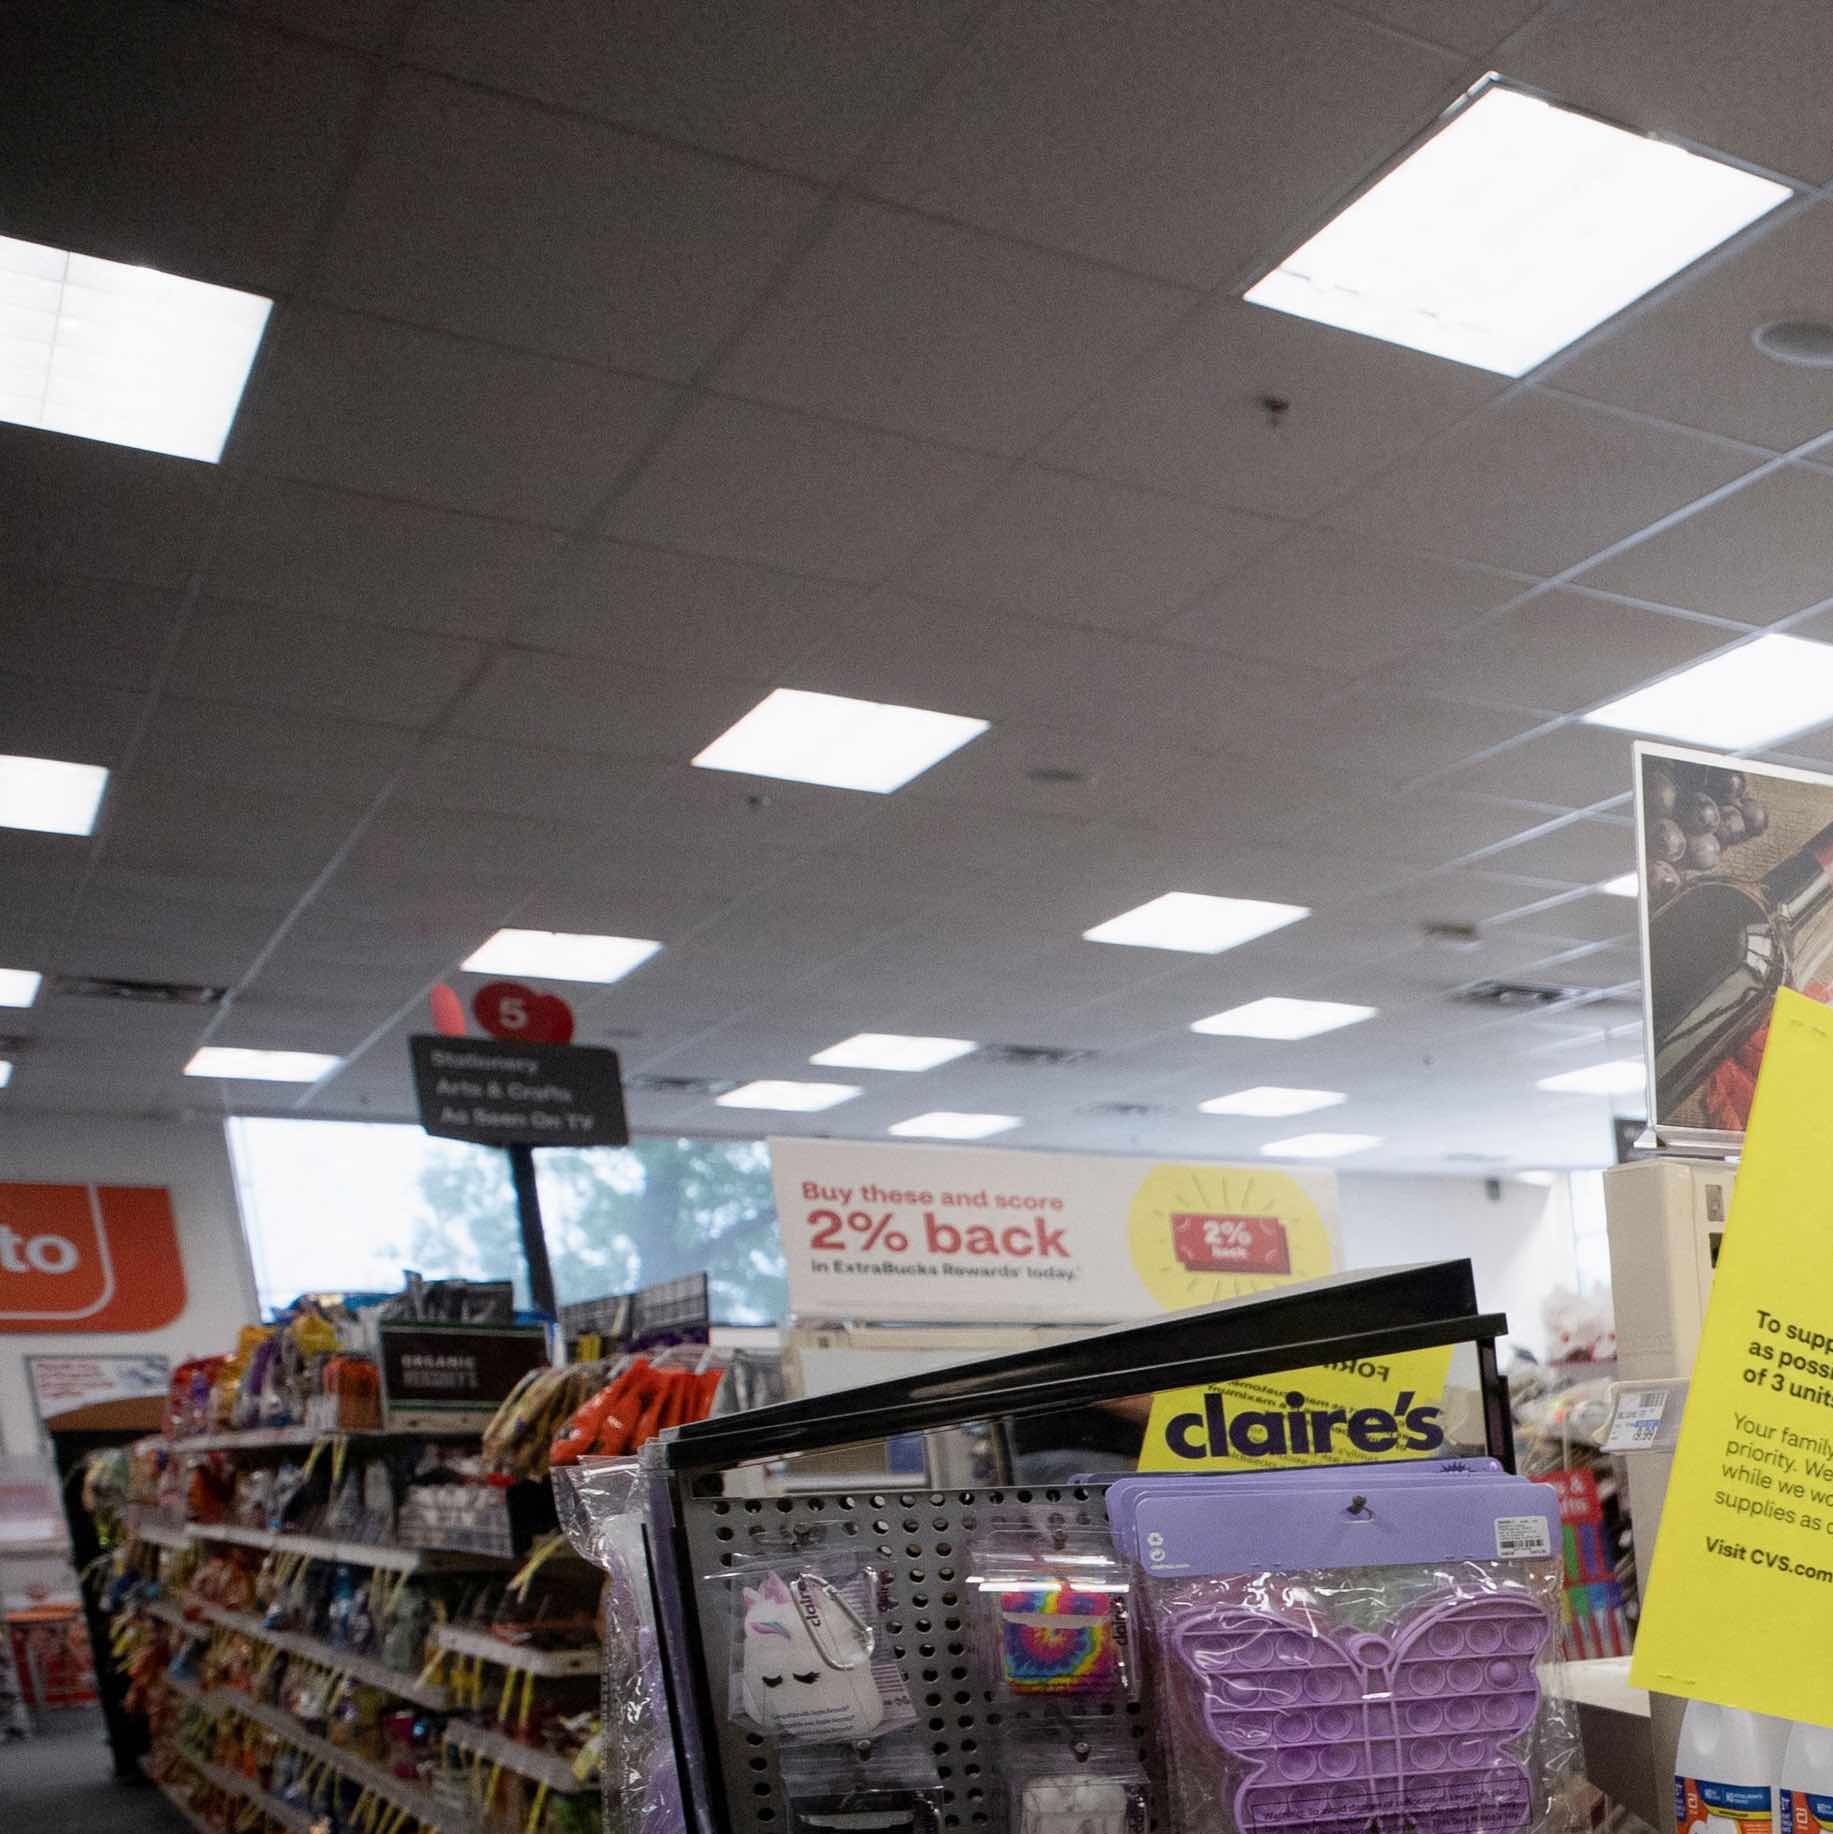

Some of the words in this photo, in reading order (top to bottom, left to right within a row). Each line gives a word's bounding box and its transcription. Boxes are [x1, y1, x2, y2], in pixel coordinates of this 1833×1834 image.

[500, 997, 528, 1030] 5
[802, 1180, 854, 1206] Buy
[861, 1184, 935, 1206] these
[940, 1188, 989, 1208] and
[994, 1193, 1065, 1211] score
[806, 1208, 909, 1252] 2%
[922, 1210, 1072, 1258] back
[1202, 1219, 1252, 1247] 2%
[810, 1259, 829, 1273] in
[832, 1259, 938, 1277] ExtraBucks
[1755, 1309, 1782, 1334] To
[1747, 1339, 1774, 1360] as
[1742, 1367, 1769, 1385] of
[1770, 1373, 1786, 1393] 3
[1163, 1389, 1445, 1460] claire's
[1733, 1410, 1778, 1441] Your
[1724, 1437, 1798, 1474] priority.
[1720, 1461, 1773, 1490] while
[1777, 1479, 1806, 1500] we
[1713, 1488, 1798, 1525] supplies
[1799, 1512, 1823, 1532] as
[1704, 1535, 1748, 1562] Visit
